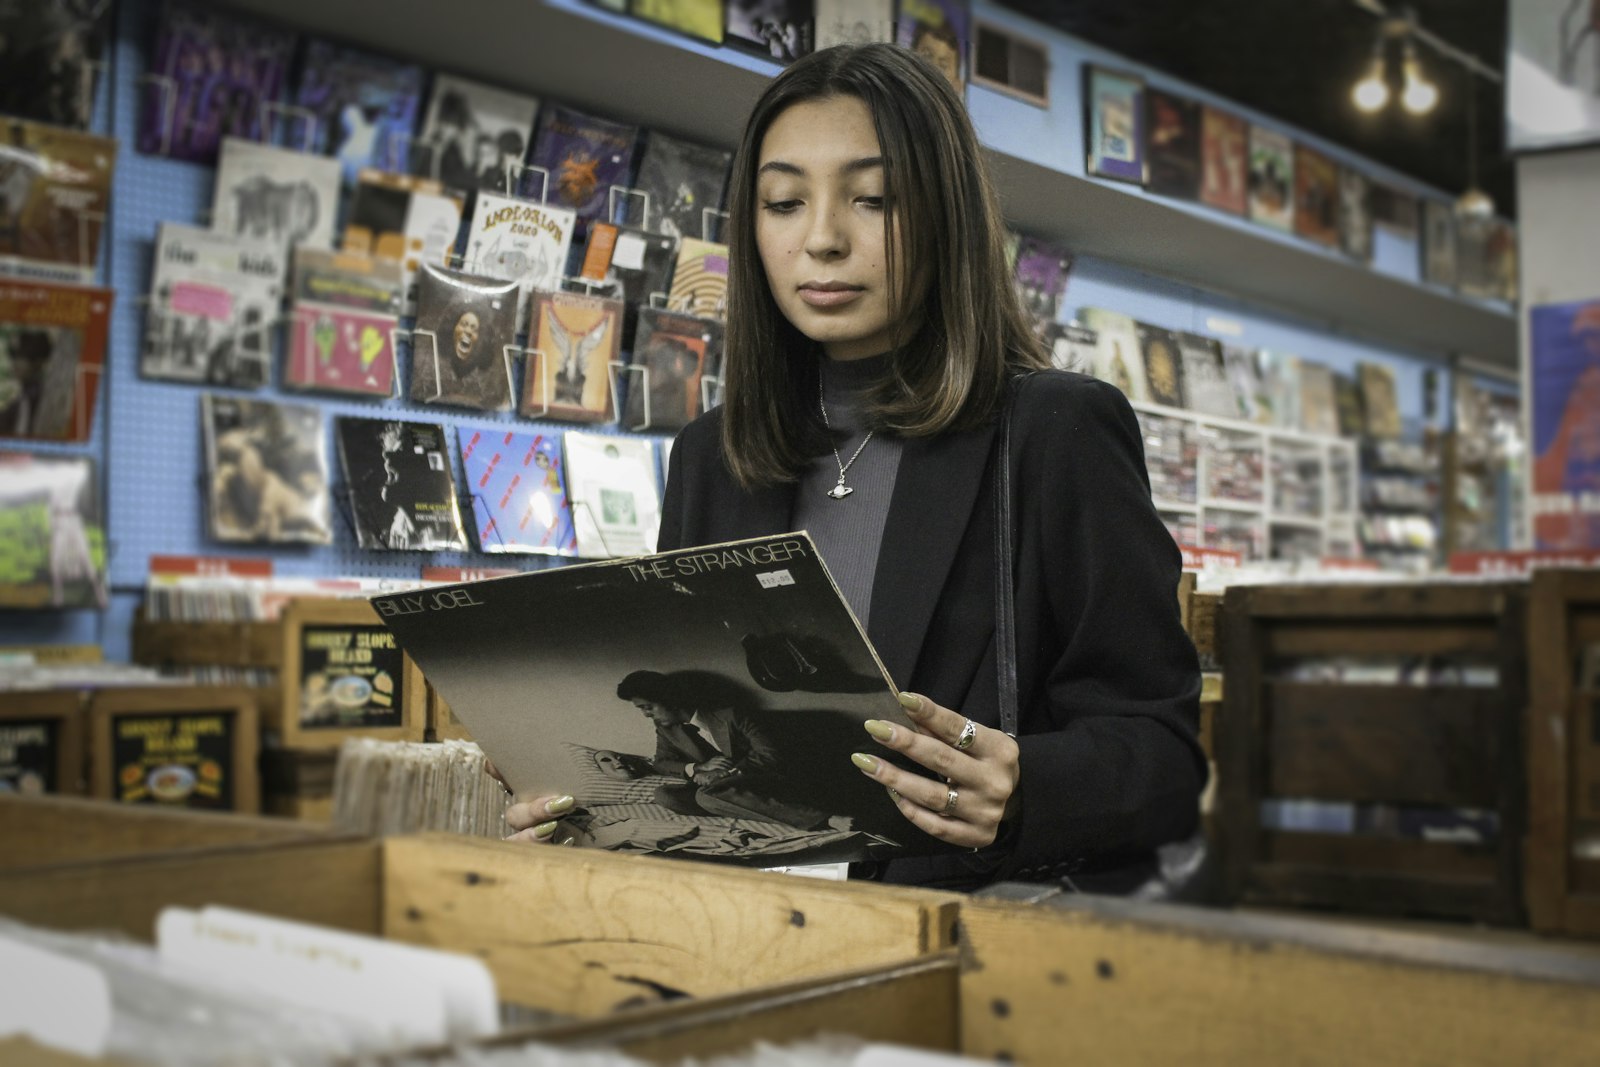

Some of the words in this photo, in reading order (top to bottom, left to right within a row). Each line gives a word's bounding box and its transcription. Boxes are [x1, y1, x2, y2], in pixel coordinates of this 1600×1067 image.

[622, 559, 675, 582] THE
[675, 540, 806, 576] STRANGER
[376, 594, 425, 616] BILLY
[430, 589, 484, 610] JOEL
[356, 631, 396, 649] SLOPE
